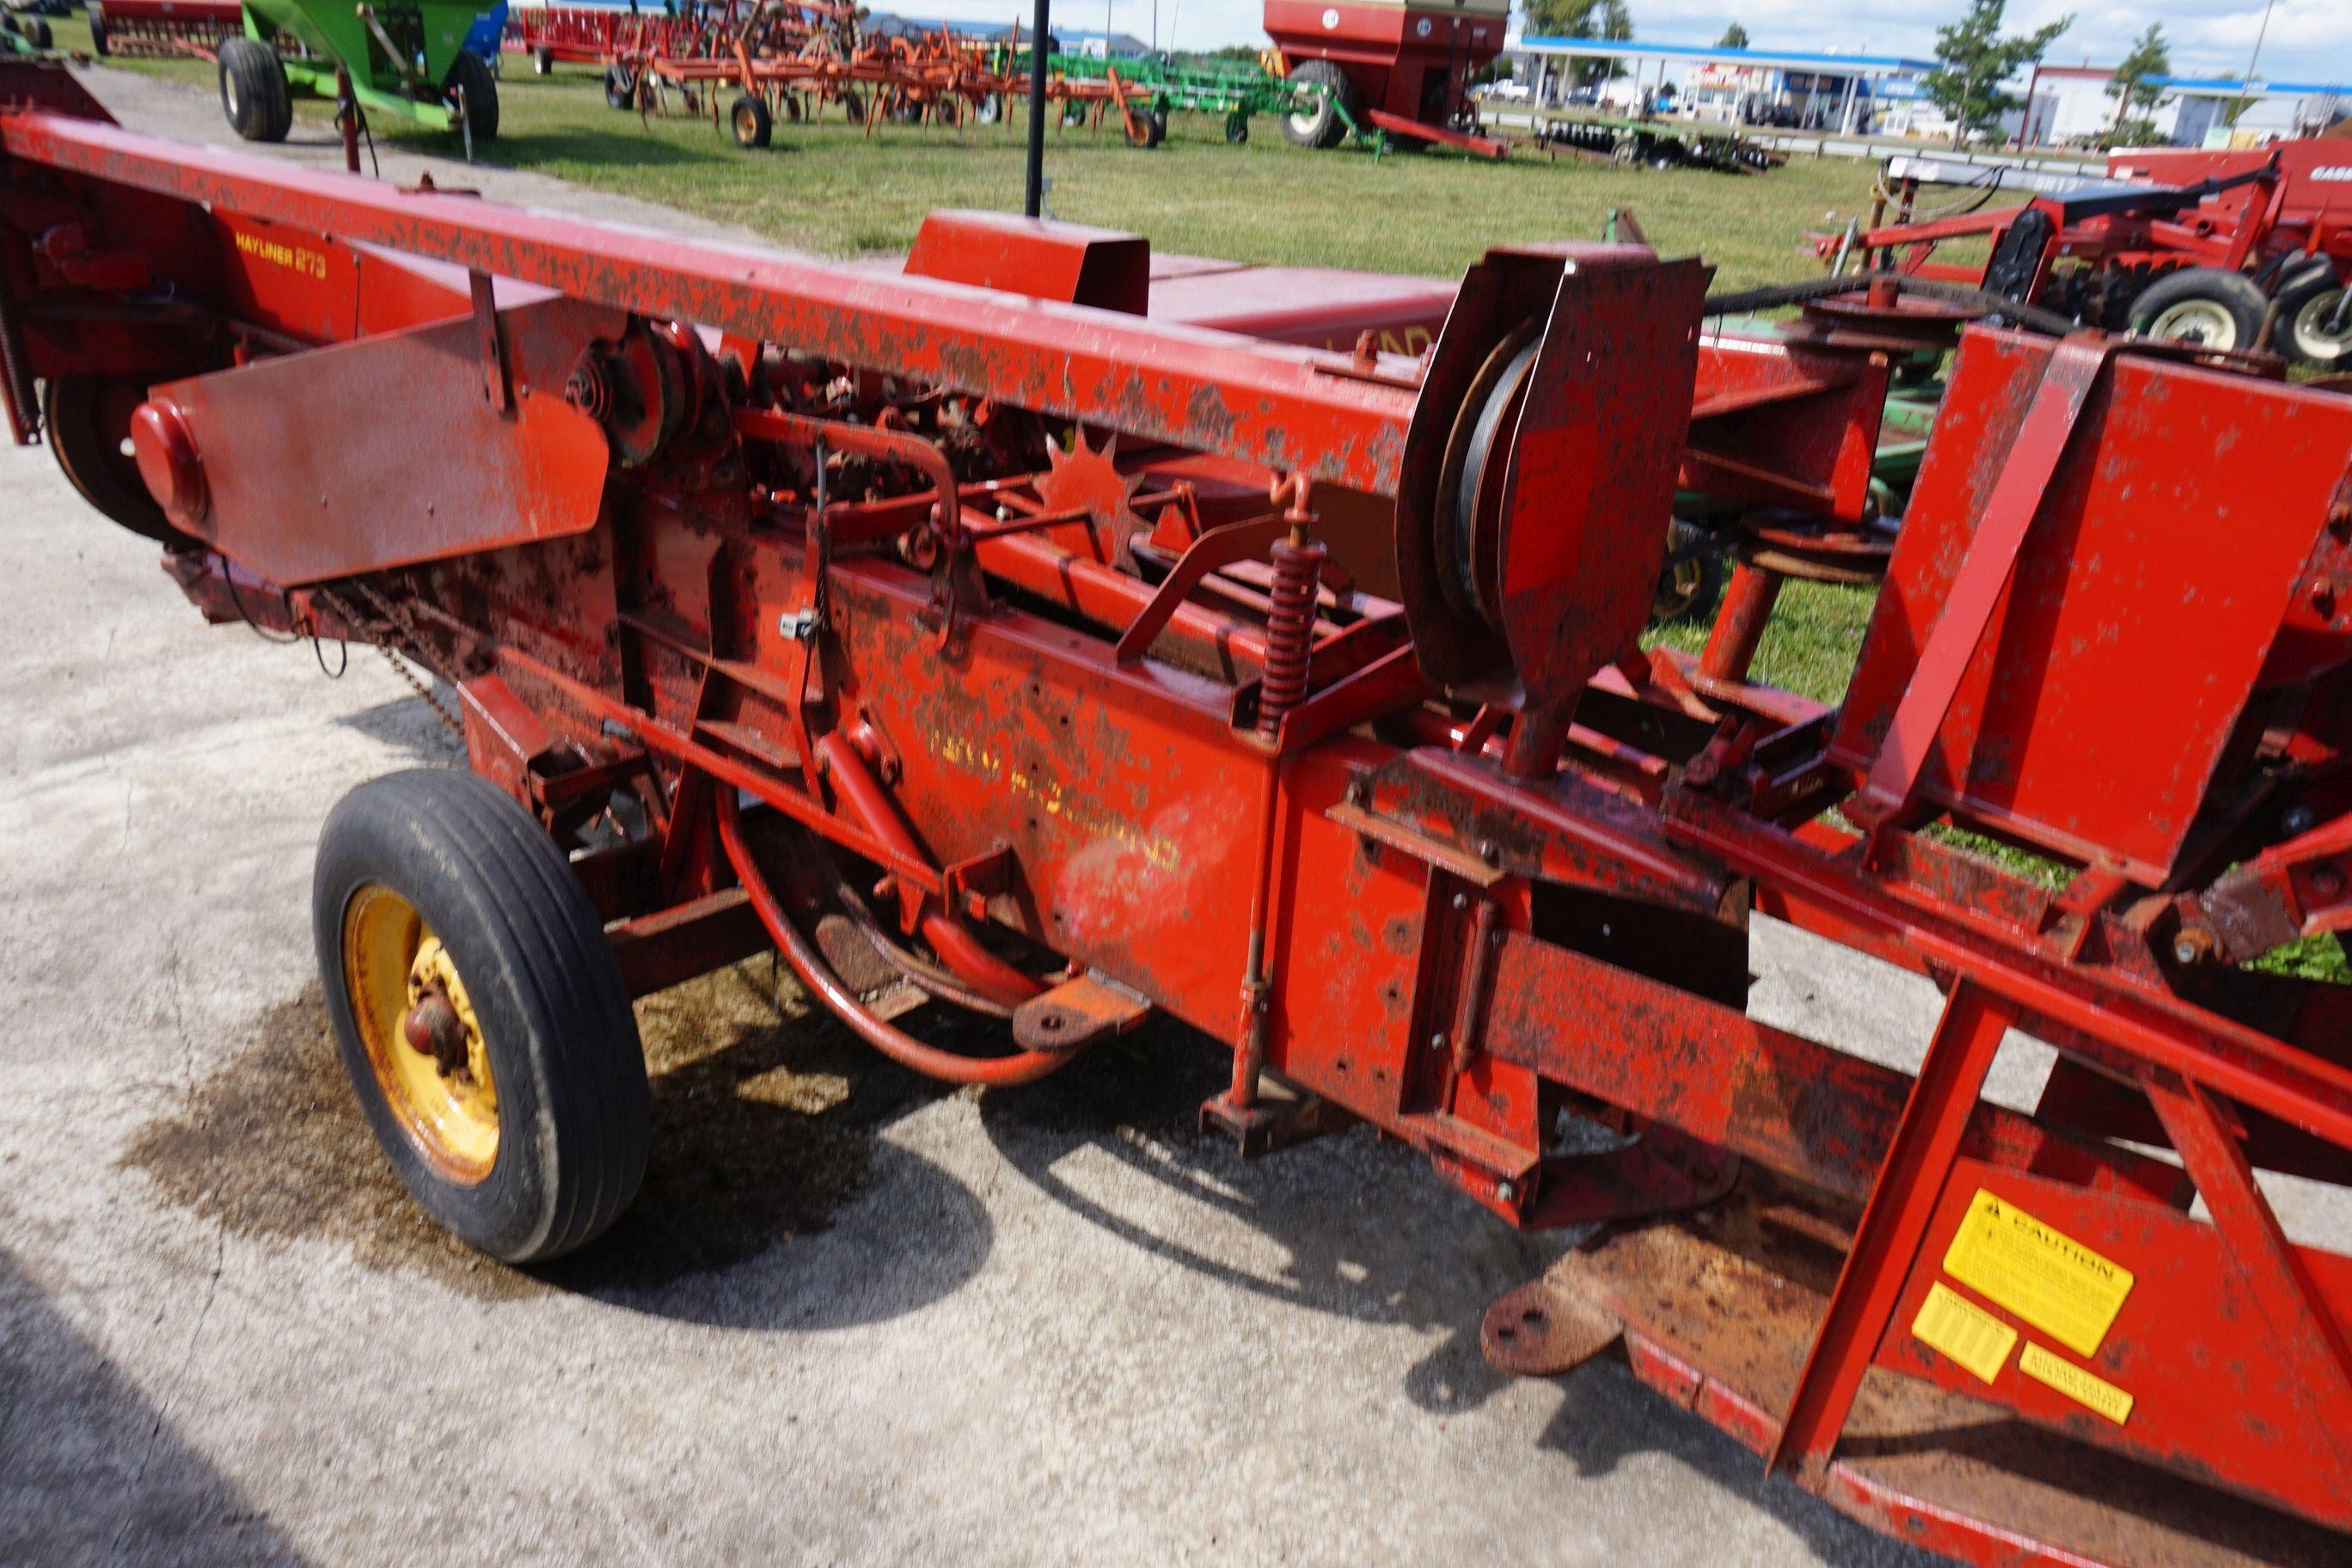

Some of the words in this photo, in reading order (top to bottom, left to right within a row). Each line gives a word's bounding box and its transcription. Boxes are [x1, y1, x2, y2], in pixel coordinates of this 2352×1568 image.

[235, 230, 293, 268] HAYLINER
[295, 246, 327, 280] 273
[2012, 1214, 2116, 1281] CAUTION
